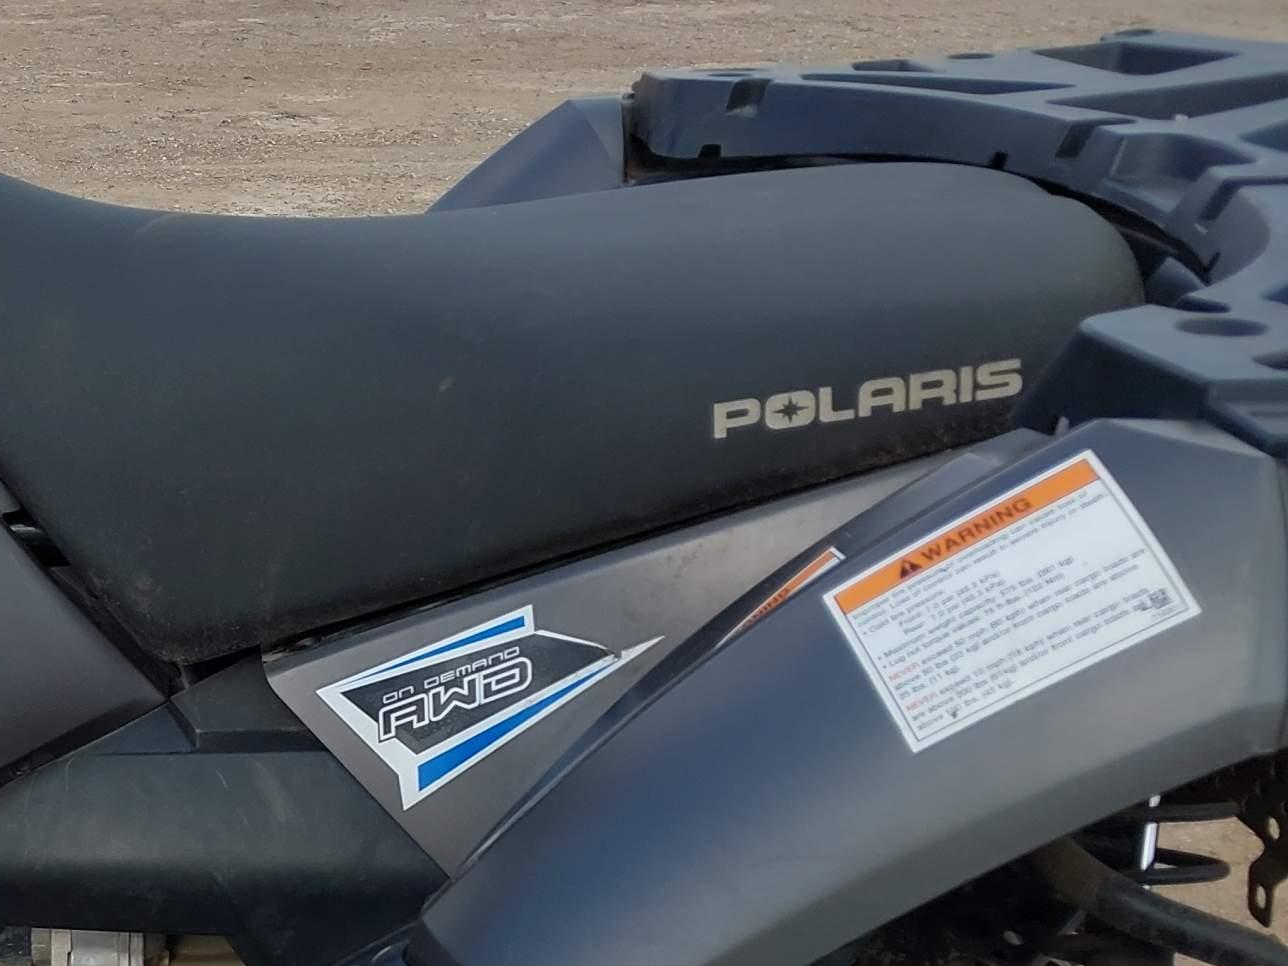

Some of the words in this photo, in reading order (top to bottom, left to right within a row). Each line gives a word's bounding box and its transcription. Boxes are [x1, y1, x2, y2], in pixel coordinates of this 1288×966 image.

[713, 358, 1023, 439] POLARIS
[919, 494, 1035, 564] WARNING
[378, 656, 533, 742] AWD
[383, 686, 415, 703] ON
[424, 646, 520, 689] DEMAND
